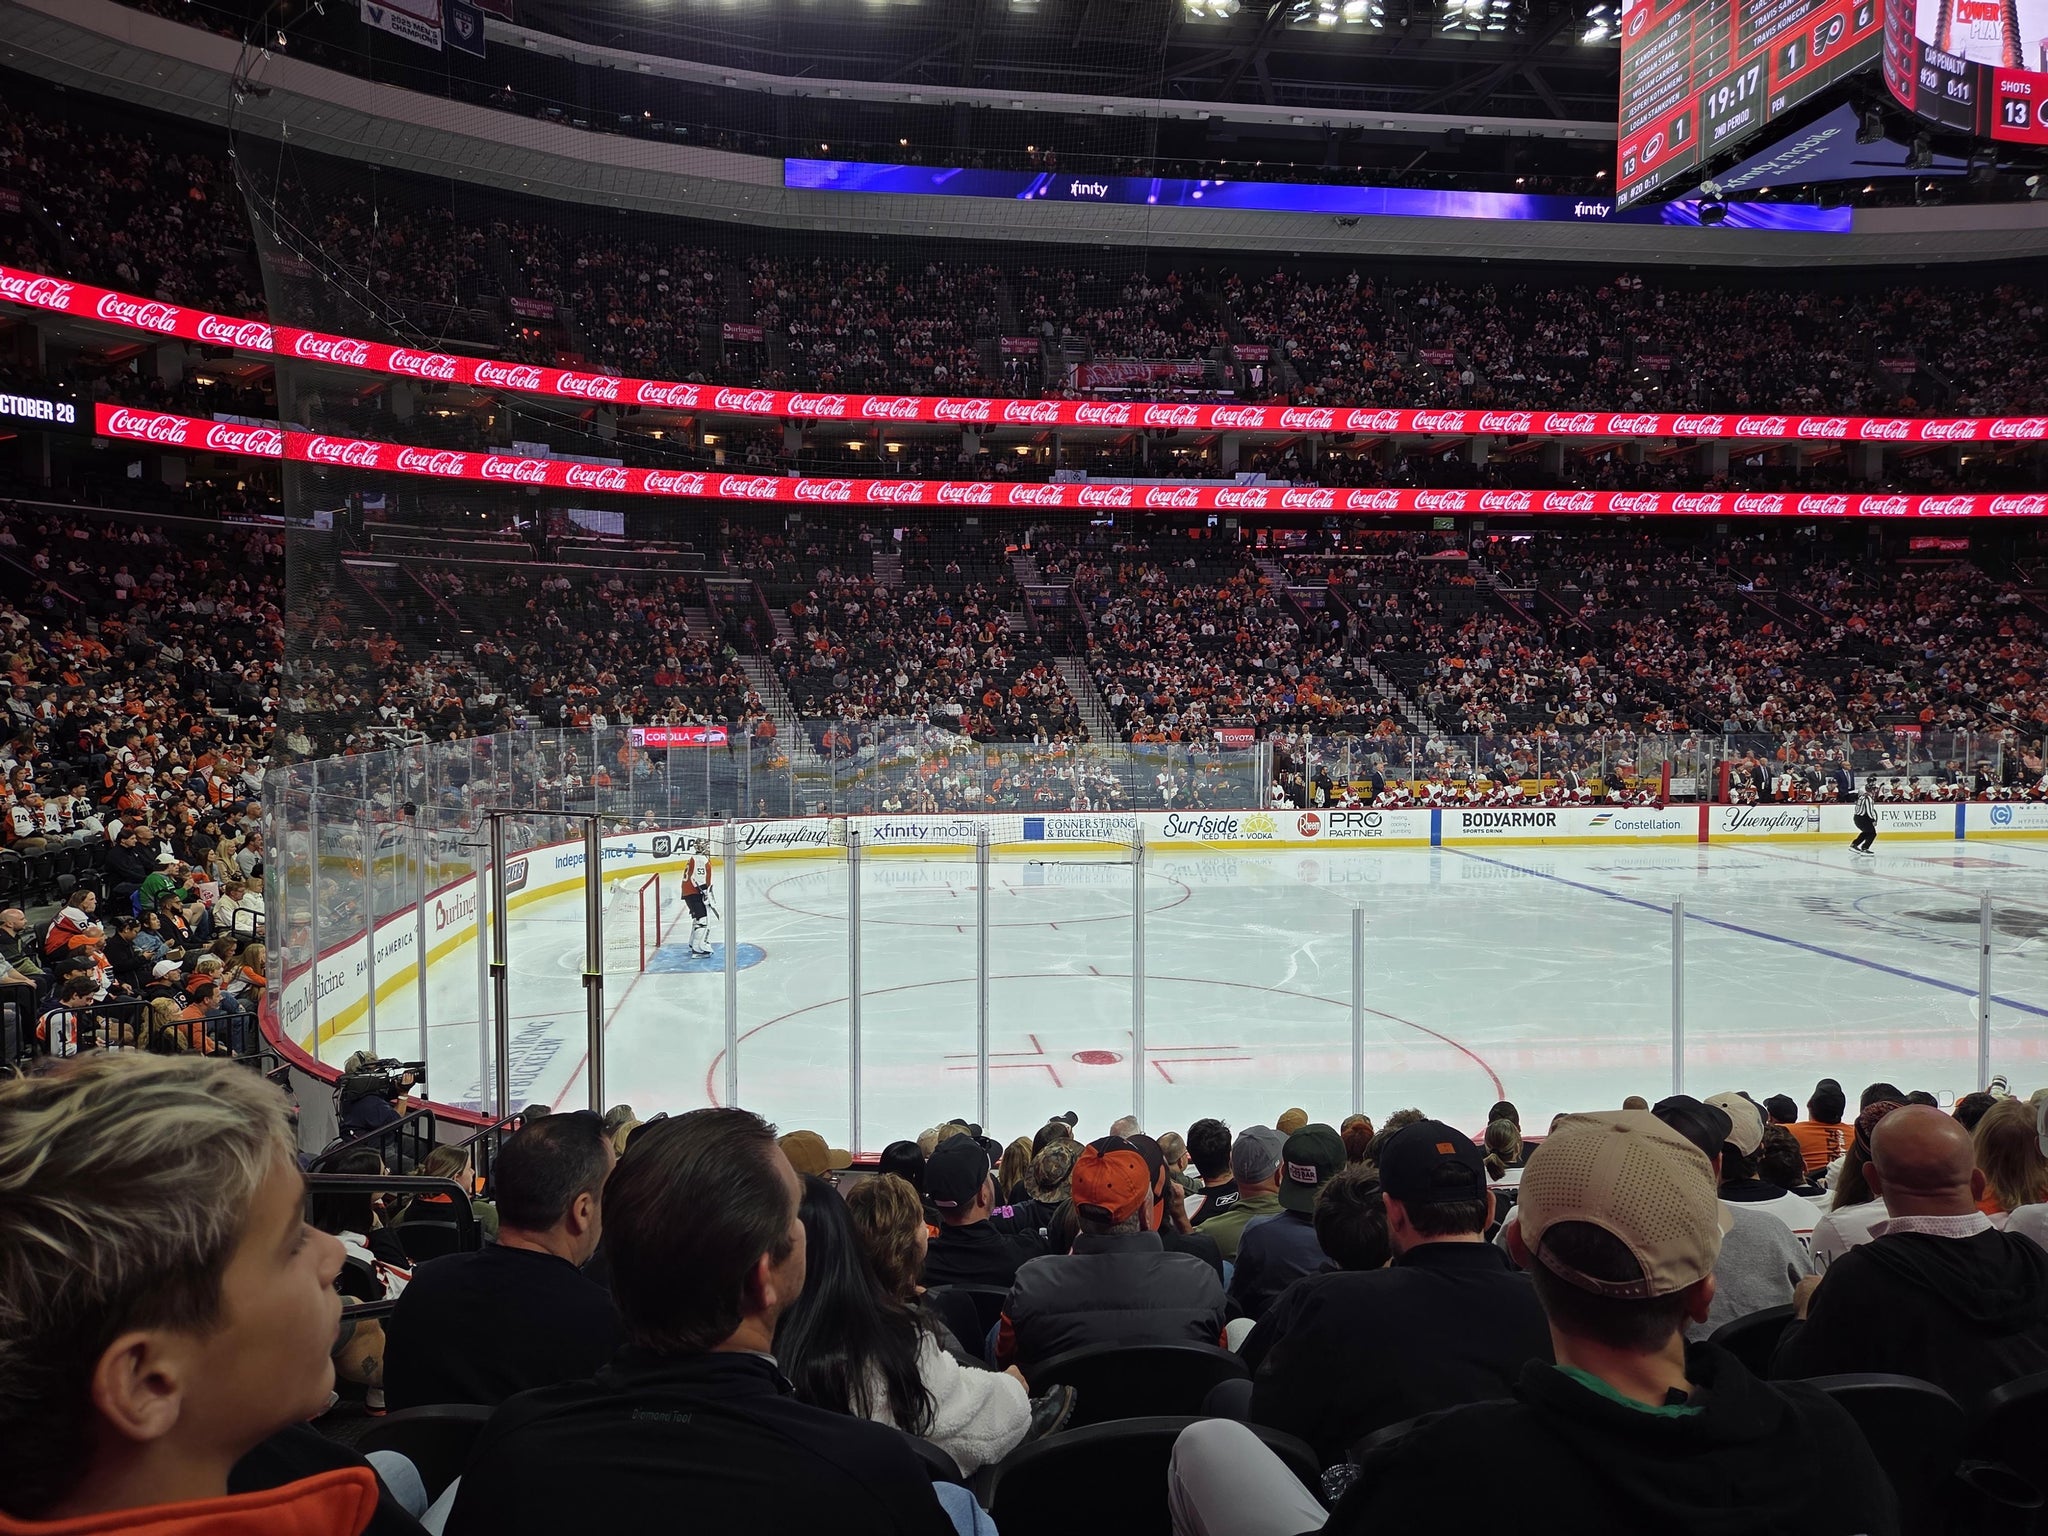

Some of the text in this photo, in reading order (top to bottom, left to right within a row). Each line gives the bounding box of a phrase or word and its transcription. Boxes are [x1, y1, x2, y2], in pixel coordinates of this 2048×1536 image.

[1668, 13, 1681, 27] HITS
[1754, 8, 1777, 29] TRAVIS
[1858, 6, 1869, 26] 6
[1957, 0, 2001, 21] POWER
[391, 23, 438, 46] CHAMPIONS
[1753, 3, 1811, 47] TRAVIS KONECNY
[1969, 21, 2004, 40] PLAY
[1658, 30, 1679, 49] MILLER
[1636, 49, 1676, 82] JORDAN STAAL
[1787, 45, 1797, 69] 1
[1924, 47, 1967, 75] CAR PENALTY
[1632, 61, 1679, 100] WILLIAM CARRIER
[1920, 69, 1970, 99] #20 0:11
[2001, 80, 2031, 94] SHOTS
[1628, 74, 1683, 118] JESPERI KOTKANIEMI
[1707, 65, 1760, 119] 19:17
[1630, 92, 1680, 132] LOGAN STANKOVEN
[1771, 98, 1785, 114] PEN
[2005, 102, 2027, 124] 13
[1676, 118, 1684, 140] 1
[1714, 108, 1751, 140] 2ND PERIOD
[1622, 144, 1637, 158] SHOTS
[1780, 126, 1842, 161] mobile
[1624, 158, 1636, 175] 13
[1772, 147, 1830, 176] ARENA
[1070, 180, 1108, 197] xfinity
[1617, 173, 1659, 207] PEN #20 0:11
[1574, 201, 1611, 217] xfinity
[96, 293, 180, 332] Coca-Cola
[197, 315, 277, 350] Coca-Cola
[294, 332, 370, 365] Coca-Cola
[388, 349, 457, 379] Coca-Cola
[474, 361, 543, 390] Coca-Cola
[556, 372, 621, 400] Coca-Cola
[636, 381, 701, 407] Coca-Cola
[714, 388, 776, 412] Coca-Cola
[787, 394, 848, 416] Coca-Cola
[861, 396, 922, 419] Coca-Cola
[933, 399, 993, 420] Coca-Cola
[1003, 401, 1061, 422] Coca-Cola
[1074, 402, 1132, 425] Coca-Cola
[1143, 404, 1201, 426] Coca-Cola
[1210, 406, 1267, 428] Coca-Cola
[1279, 408, 1336, 429] Coca-Cola
[1346, 409, 1402, 431] Coca-Cola
[1411, 411, 1467, 431] Coca-Cola
[1478, 412, 1533, 432] Coca-Cola
[1543, 413, 1598, 433] Coca-Cola
[1607, 414, 1661, 434] Coca-Cola
[1672, 415, 1725, 435] Coca-Cola
[1735, 416, 1788, 436] Coca-Cola
[1797, 417, 1849, 437] Coca-Cola
[1860, 419, 1911, 439] Coca-Cola
[1920, 420, 1978, 440] Coca-Cola
[1988, 418, 2048, 439] Coca-Cola
[0, 394, 75, 423] CTOBER 28
[108, 409, 2048, 516] Coca-Cola Coca-Cola Coca-Cola Coca-Cola Coca-Cola Coca-Cola Coca-Cola Coca-Cola Coca-Cola Coca-Cola Coca-Cola Coca-Cola Coca-Cola Coca-Cola Coca-Cola Coca-Cola Coca-Cola Coca-Cola Coca-Cola Coca-Cola Coca-Cola Coca-Cola Coca-Cola Coca-Cola Coca-Cola Coca-Cola Coca-Cola
[646, 732, 690, 742] COROLLA
[1224, 734, 1255, 742] TOYOTA
[15, 814, 28, 823] 74
[46, 814, 57, 822] 74
[1047, 817, 1136, 829] CONNER STRONG
[1164, 813, 1238, 838] Surfside
[1329, 812, 1382, 828] PRO
[1463, 812, 1556, 827] BODYARMOR
[1614, 819, 1681, 830] Constellation
[1722, 807, 1808, 831] Yuengling
[1881, 810, 1936, 821] F.W. WEBB
[736, 823, 829, 851] Yuengling
[873, 823, 928, 840] xfinity
[1048, 828, 1112, 838] & BUCKELEW
[1202, 832, 1273, 840] ICED TEA VODKA
[1329, 828, 1383, 837] PARTNER
[697, 867, 705, 875] 53
[436, 892, 478, 933] Burlingt
[377, 946, 384, 964] OF
[384, 932, 413, 957] AMERICA
